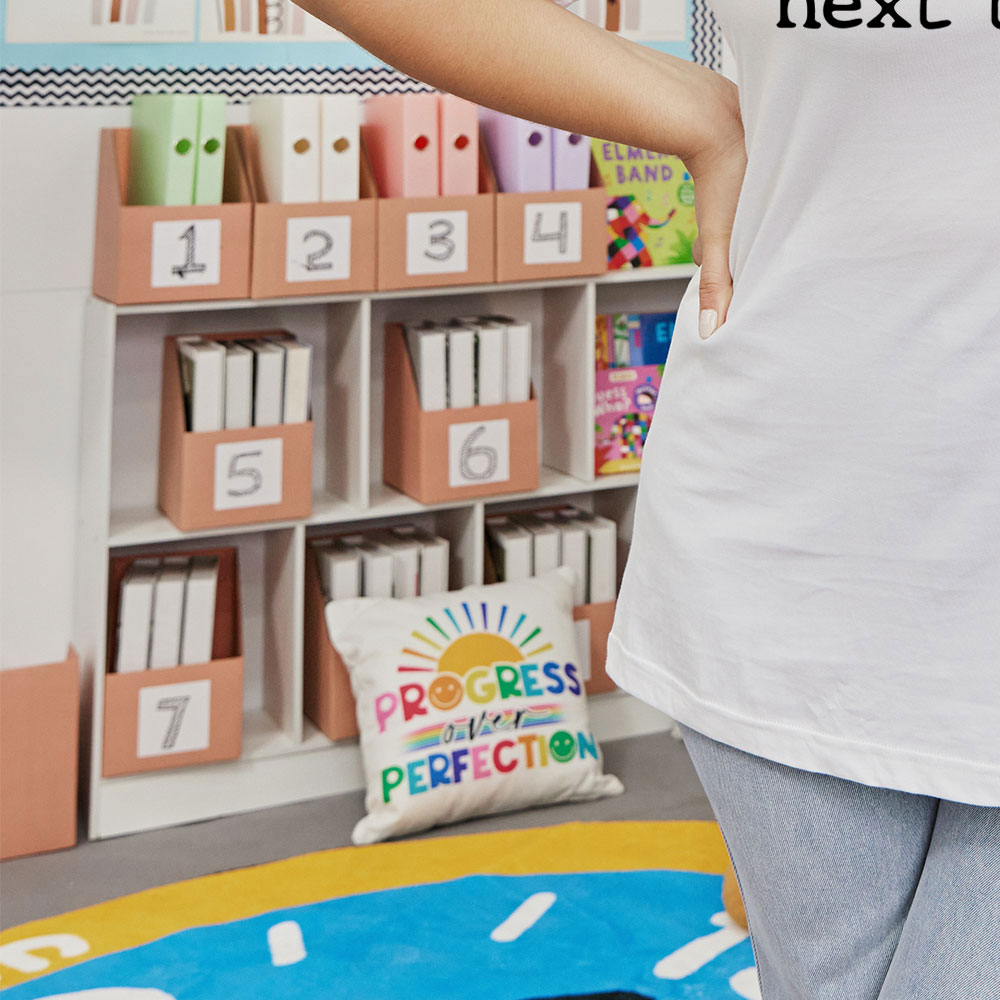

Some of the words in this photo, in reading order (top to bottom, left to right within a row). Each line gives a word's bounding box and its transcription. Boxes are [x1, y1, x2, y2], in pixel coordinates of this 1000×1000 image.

[616, 165, 673, 185] BAND
[172, 225, 207, 279] 1
[302, 229, 334, 271] 2
[424, 219, 456, 260] 3
[532, 211, 568, 254] 4
[226, 451, 263, 496] 5
[459, 425, 497, 480] 6
[375, 662, 581, 734] PROGRESS
[156, 695, 191, 750] 7
[442, 709, 530, 744] over
[381, 730, 599, 804] PERFECTION
